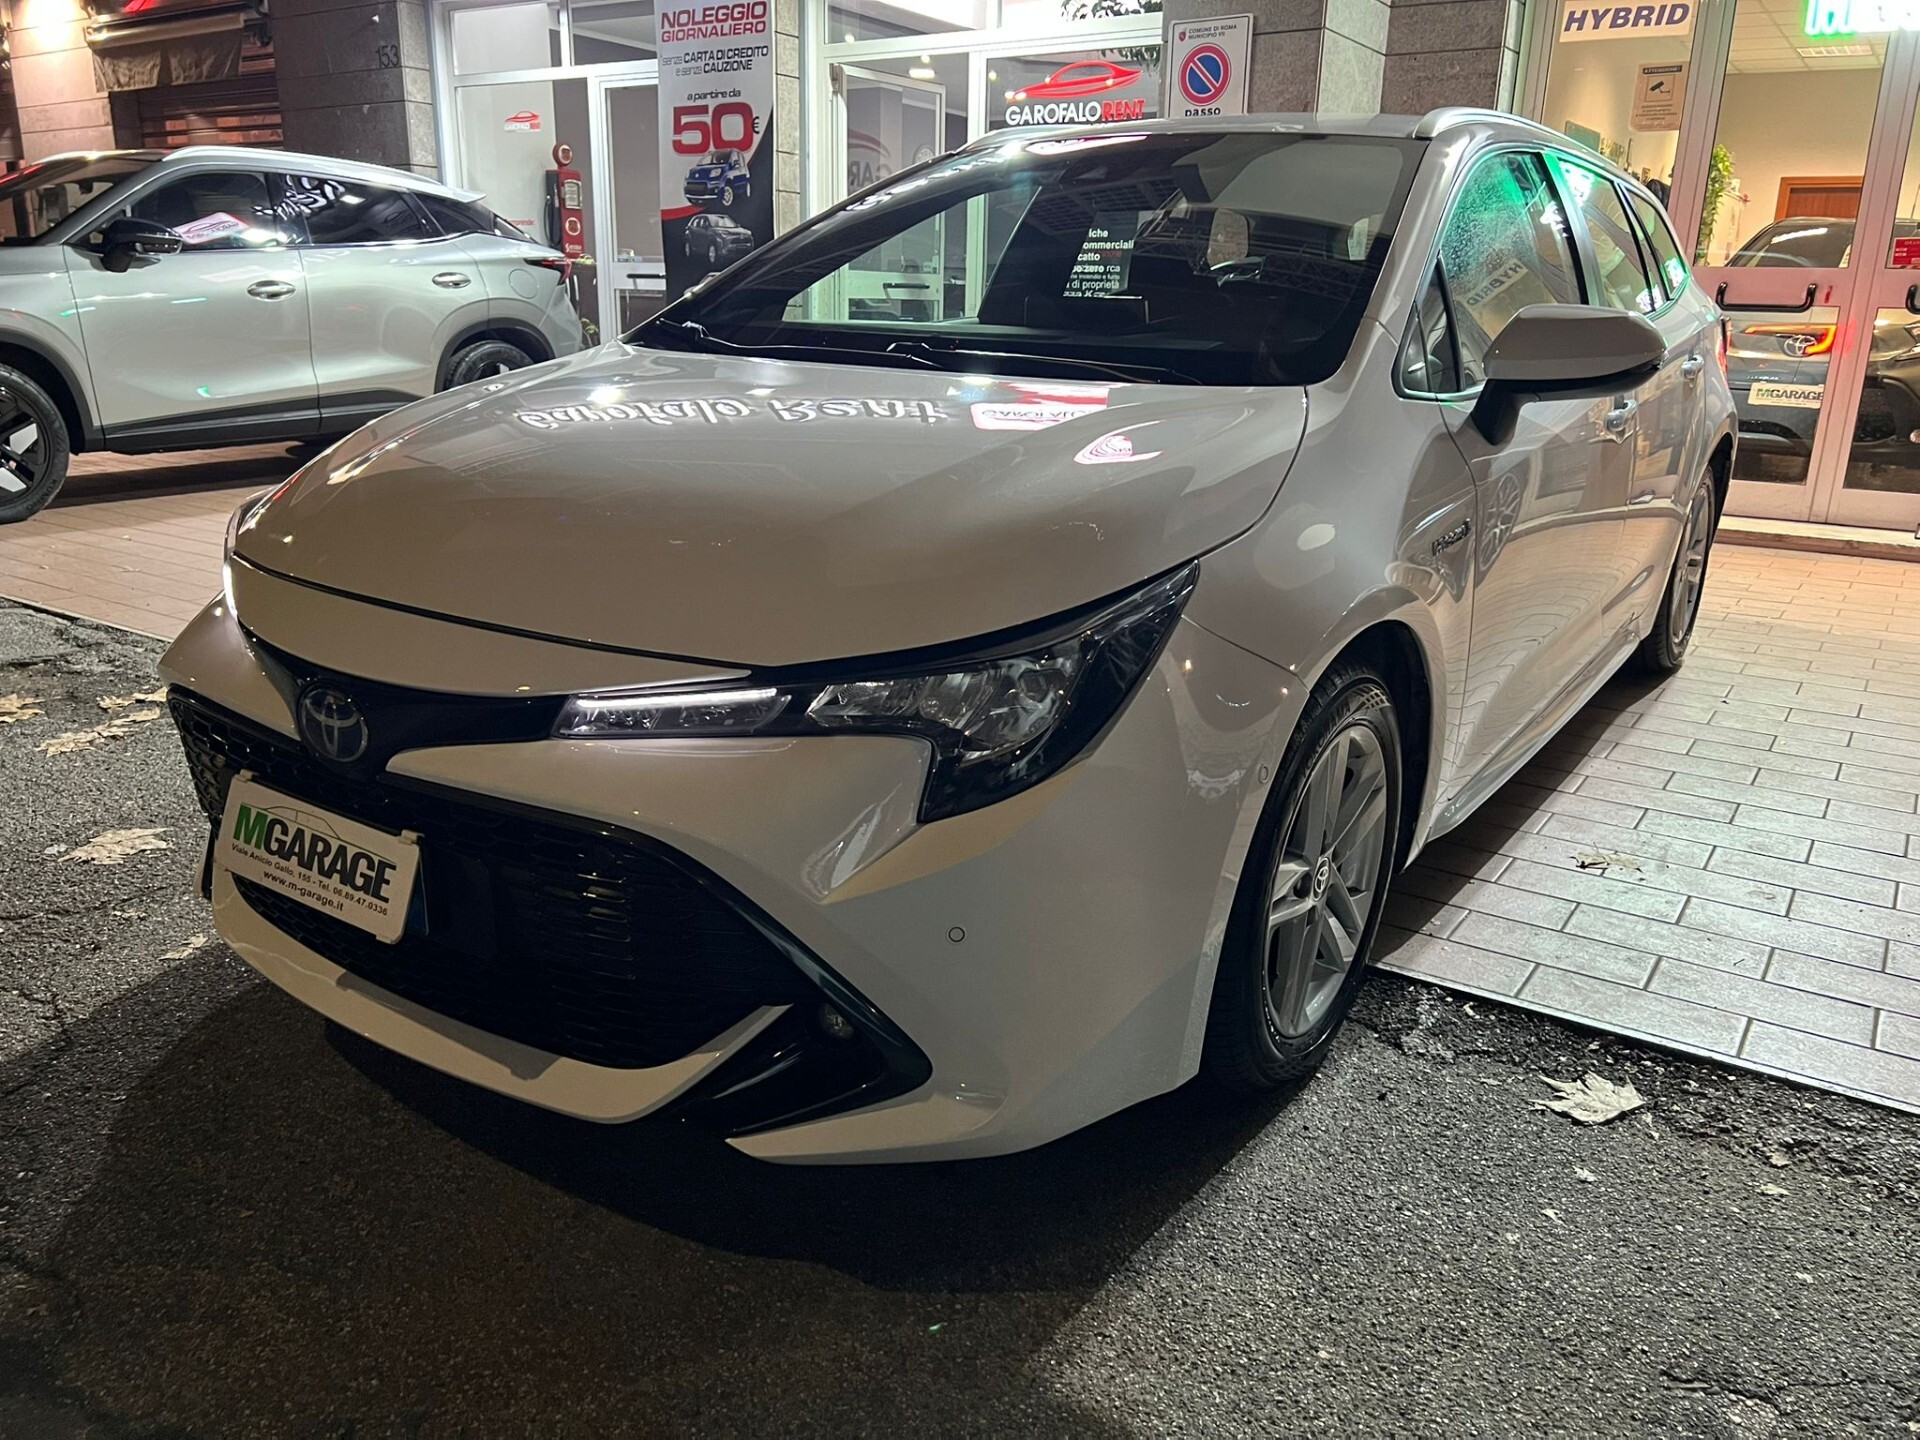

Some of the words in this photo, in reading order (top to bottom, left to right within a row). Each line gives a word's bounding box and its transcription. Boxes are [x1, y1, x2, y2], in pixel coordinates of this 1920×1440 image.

[661, 1, 768, 30] NOLEGGIO
[1563, 3, 1690, 33] HYBRID
[661, 21, 767, 43] GIORNALIERO
[375, 44, 400, 68] 153
[662, 55, 682, 66] senza
[683, 49, 716, 63] CARTA
[716, 49, 726, 60] DI
[727, 45, 769, 59] CREDITO
[681, 66, 702, 76] senza
[703, 59, 753, 74] CAUZIONE
[687, 93, 693, 101] a
[693, 89, 728, 102] partire
[728, 88, 741, 98] da
[1184, 107, 1221, 117] passo
[1082, 264, 1105, 273] zero
[1071, 280, 1080, 288] di
[1082, 280, 1120, 291] proprietà
[232, 803, 397, 904] MGARAGE
[231, 842, 249, 857] Viale
[249, 850, 273, 867] Anicio
[274, 860, 296, 878] Gallo,
[297, 871, 312, 884] 155
[318, 879, 331, 893] Tel.
[333, 885, 388, 916] 06.89.47.0336
[263, 871, 345, 912] www.m-garage.it
